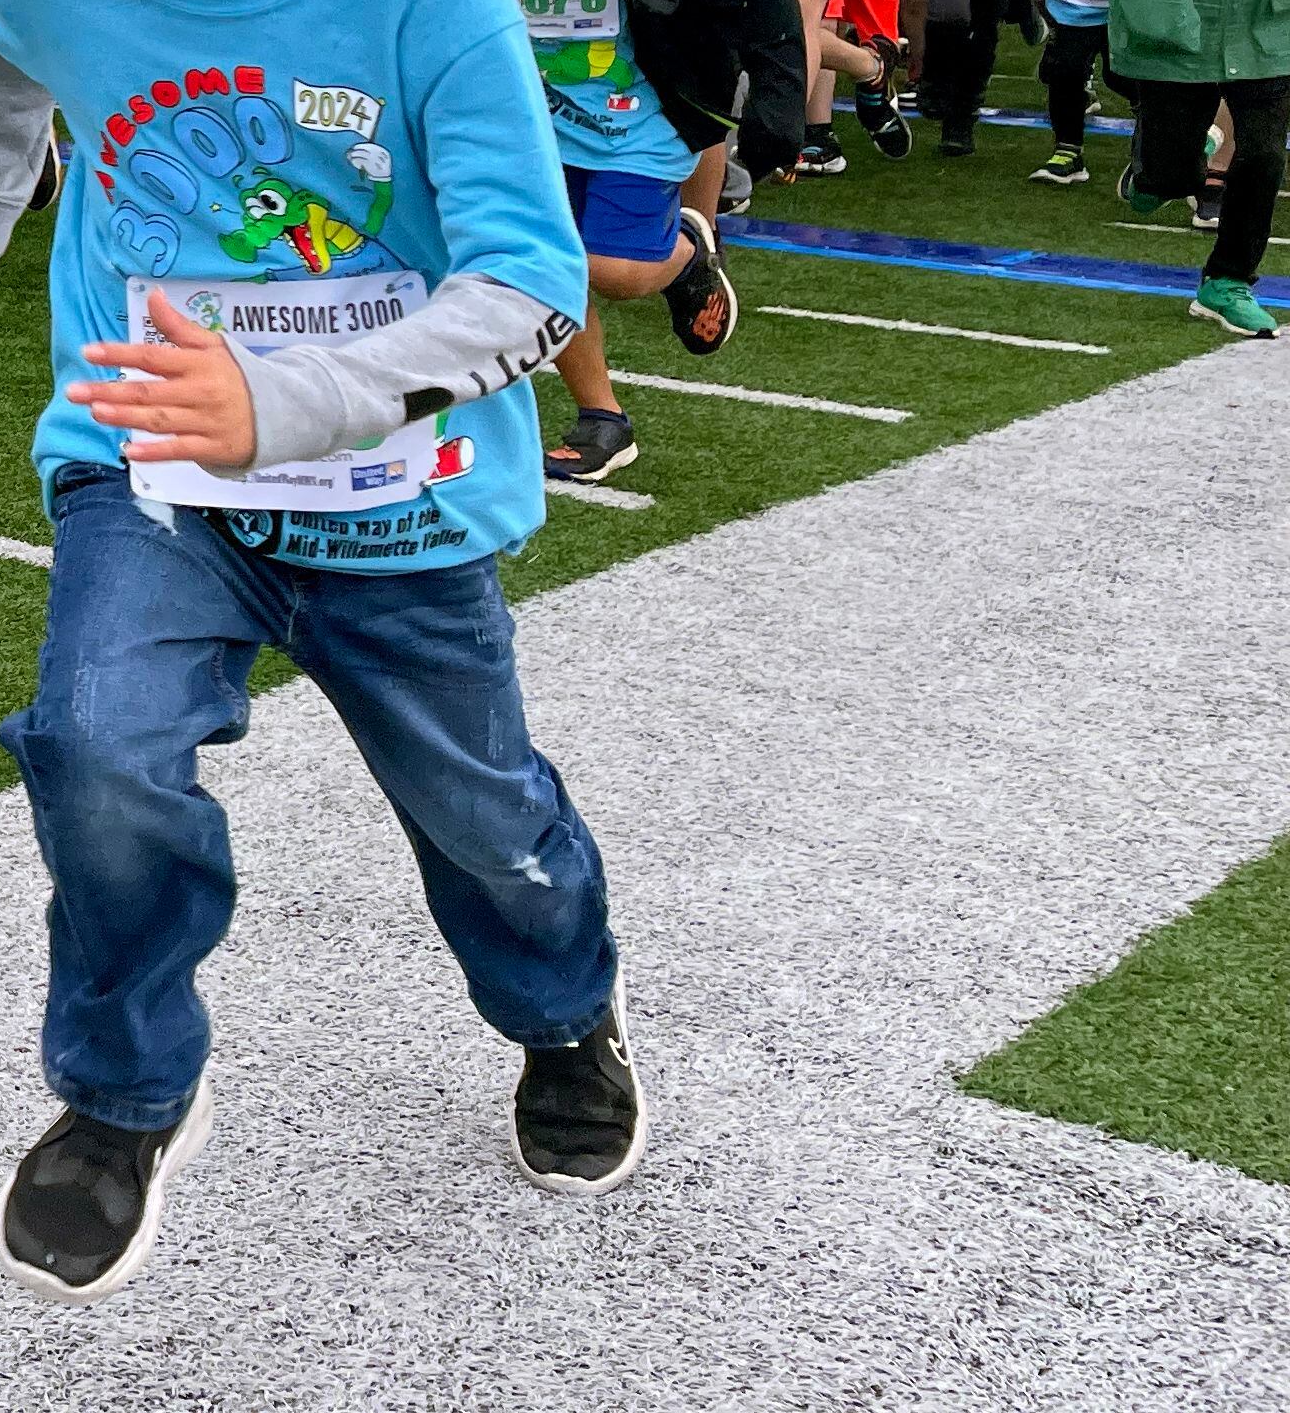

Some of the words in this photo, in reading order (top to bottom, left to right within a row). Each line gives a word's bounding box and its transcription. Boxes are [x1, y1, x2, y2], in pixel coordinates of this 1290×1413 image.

[299, 89, 372, 132] 2024
[110, 95, 294, 279] 3000
[232, 304, 339, 335] AWESOME
[345, 297, 405, 331] 3000
[396, 510, 415, 534] of
[286, 532, 419, 560] Mid-Willamette
[423, 527, 469, 552] Valley
